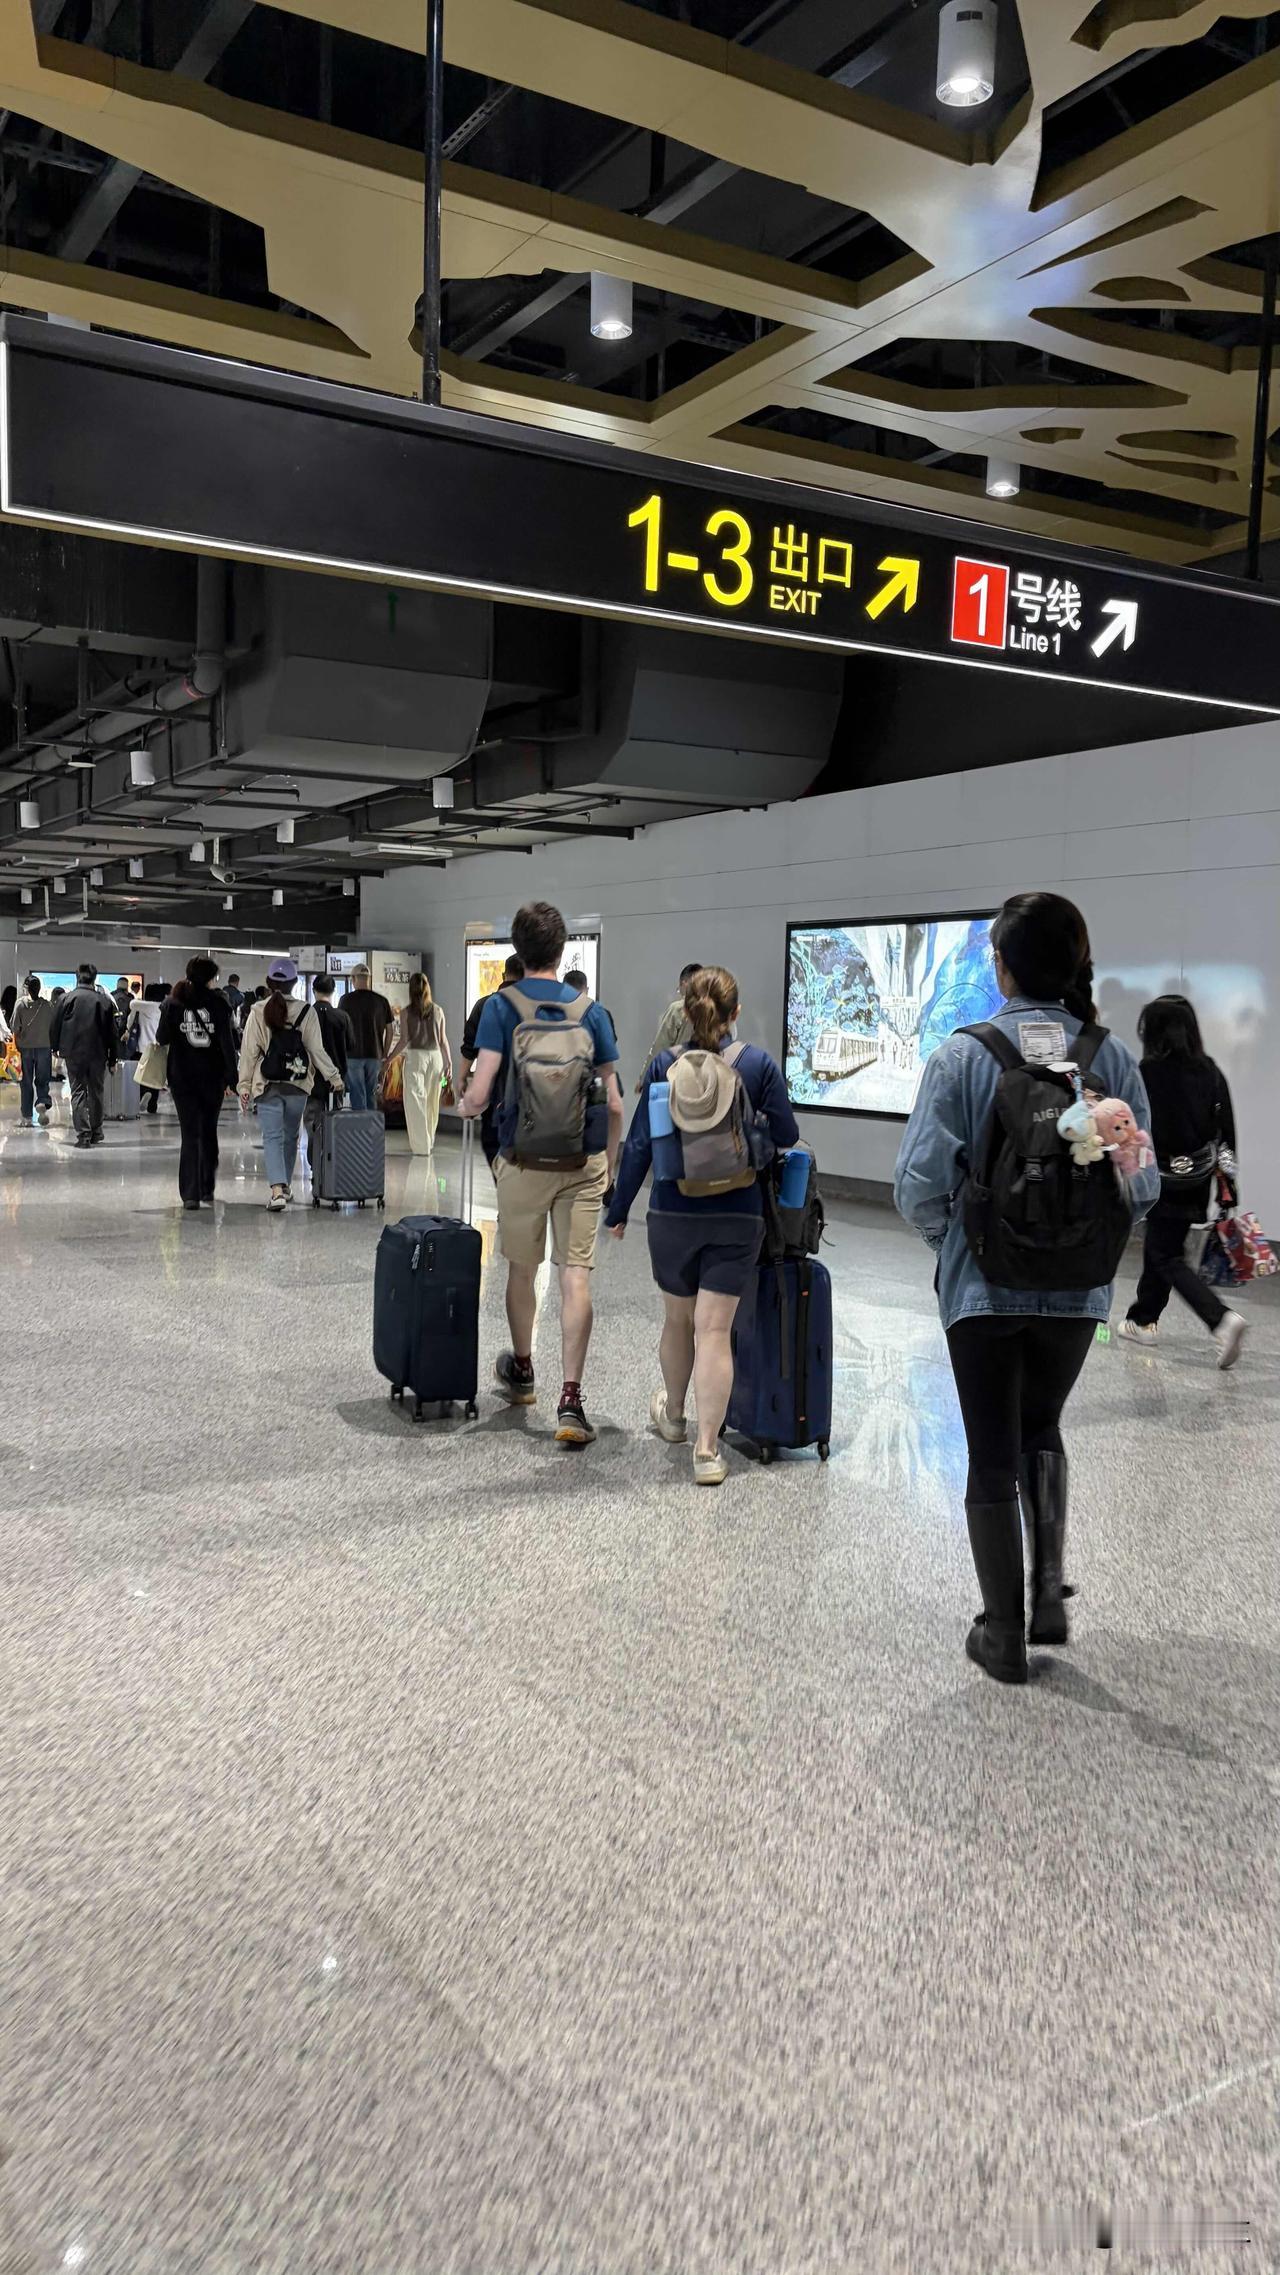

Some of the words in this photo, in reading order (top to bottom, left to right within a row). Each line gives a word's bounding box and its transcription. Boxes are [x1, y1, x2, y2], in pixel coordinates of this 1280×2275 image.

[628, 494, 753, 606] 1-3
[770, 524, 852, 588] 出口
[769, 584, 822, 615] EXIT
[969, 573, 989, 637] 1
[1010, 572, 1082, 631] 号线
[1009, 625, 1048, 653] Line
[1052, 632, 1061, 656] 1
